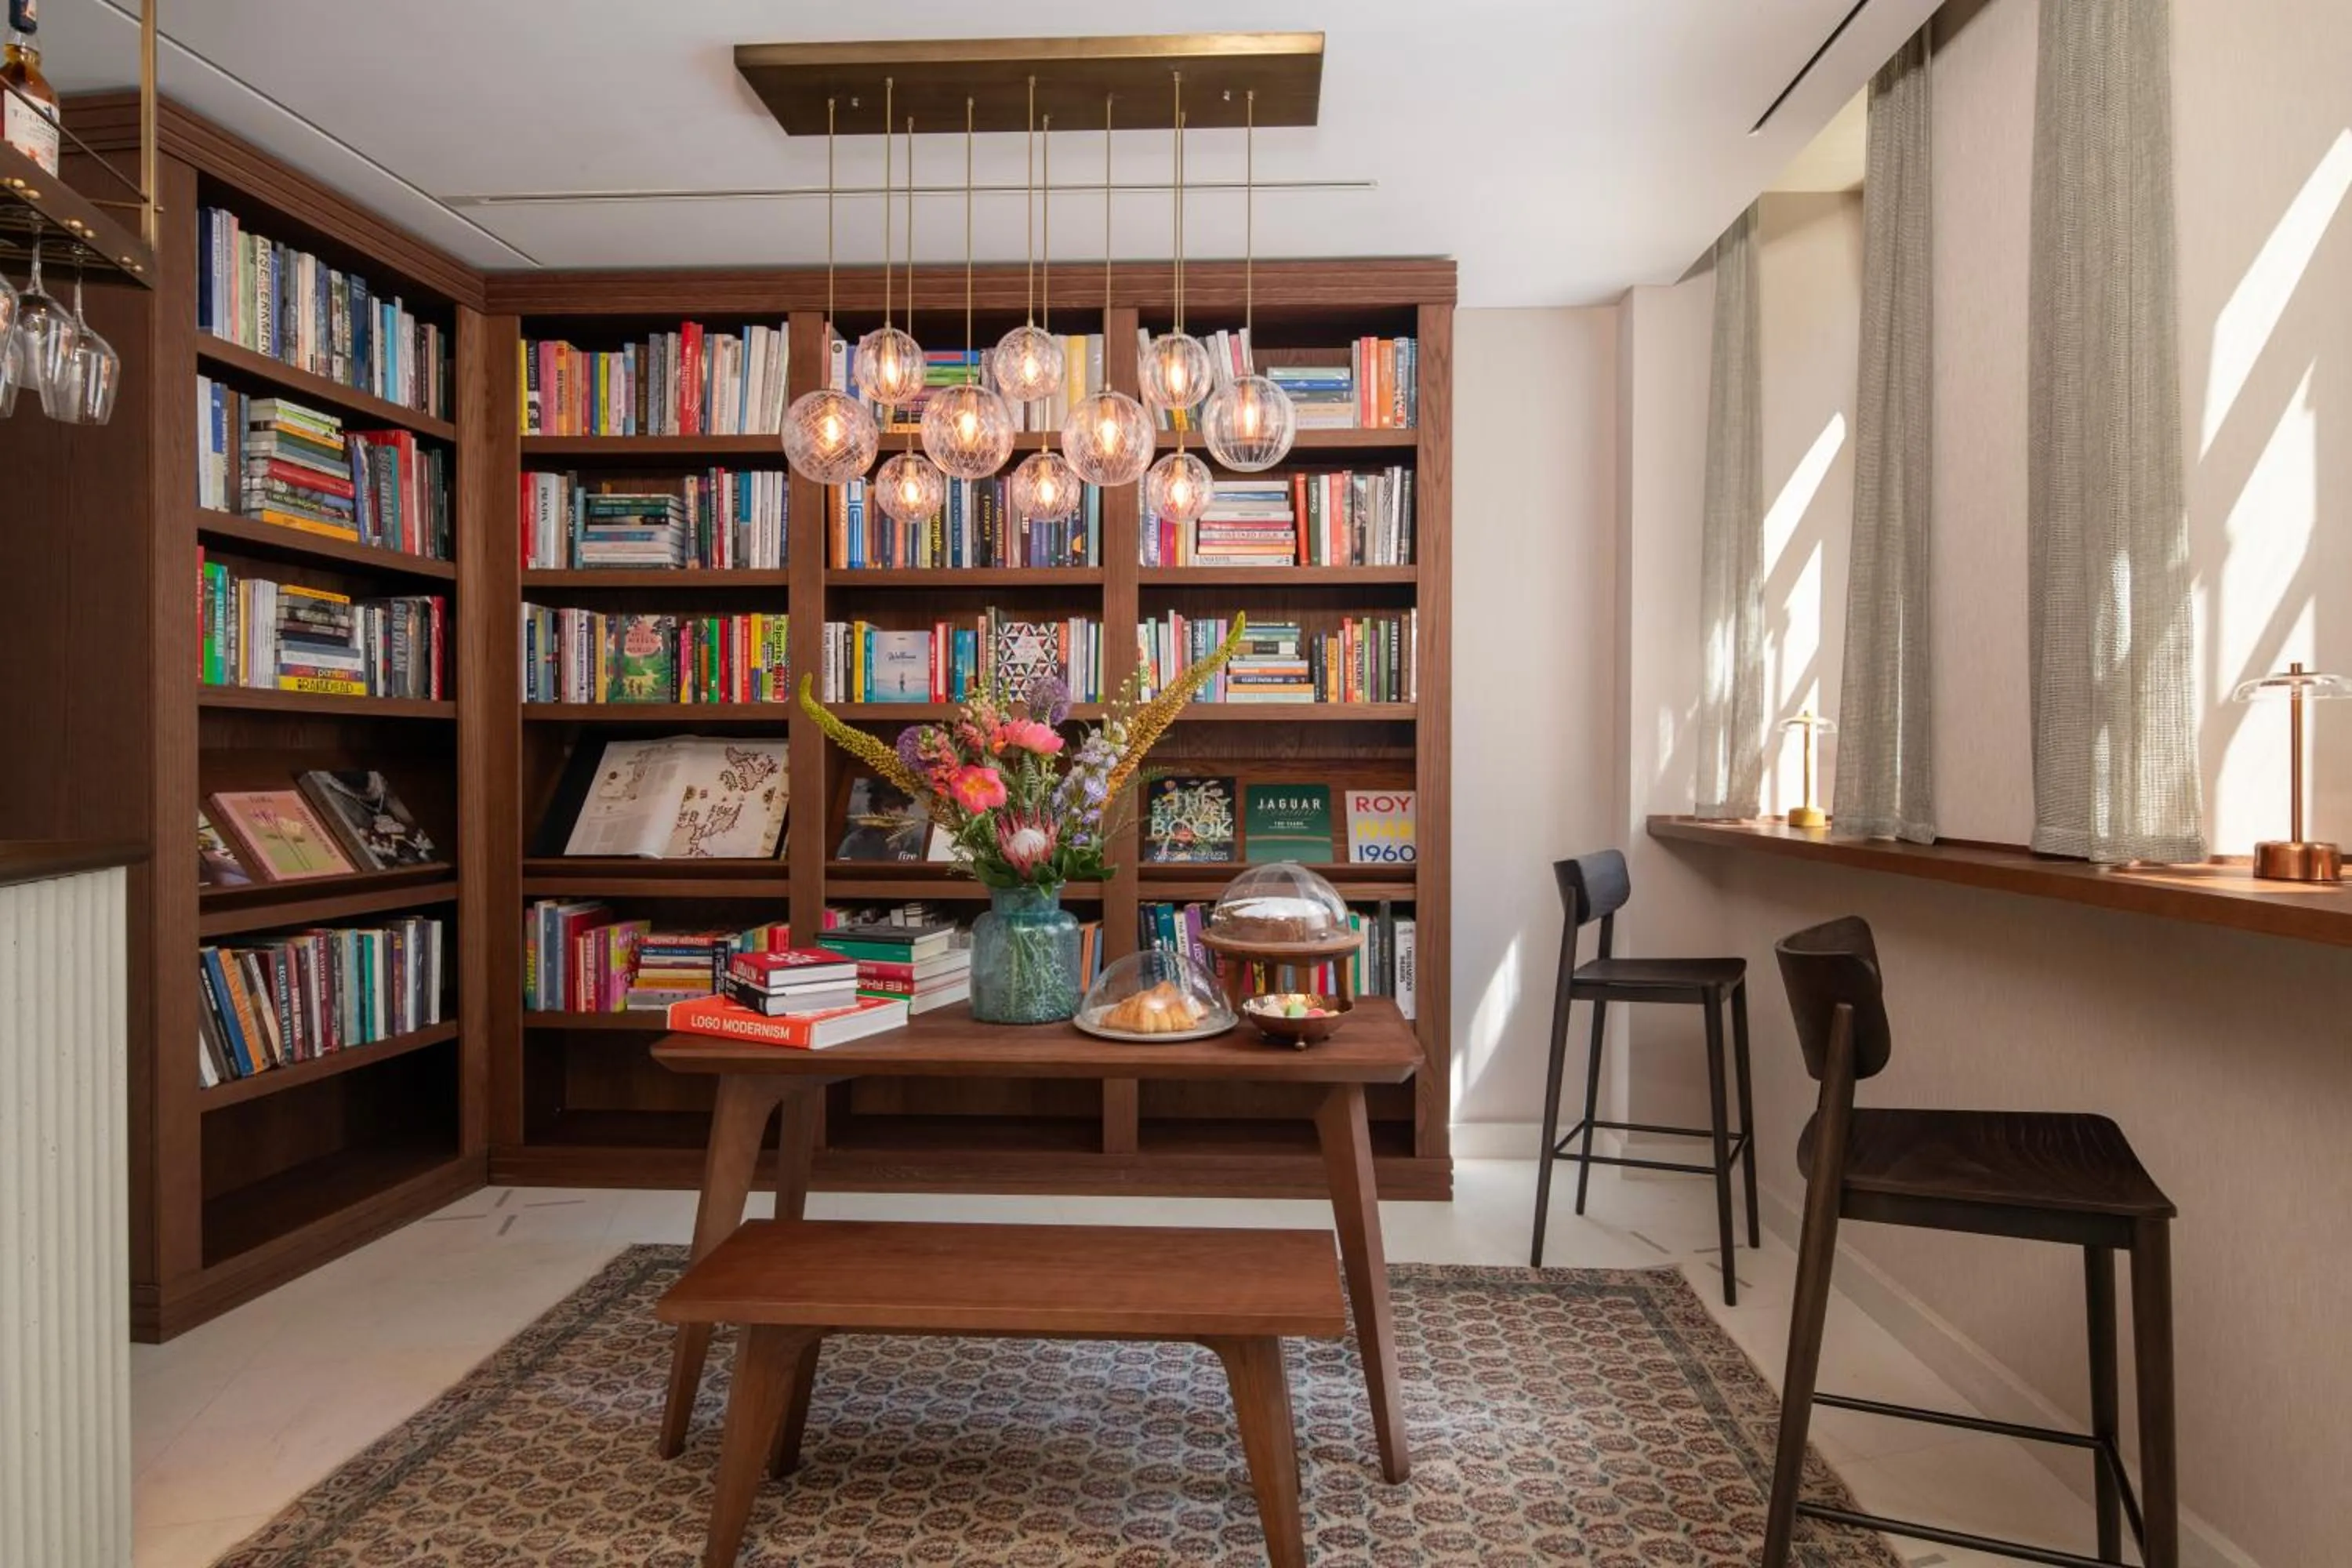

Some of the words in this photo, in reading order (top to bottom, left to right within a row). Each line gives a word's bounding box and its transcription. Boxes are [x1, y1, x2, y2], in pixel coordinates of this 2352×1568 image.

[1257, 797, 1321, 811] JAGUAR
[1355, 796, 1412, 813] ROY
[1151, 816, 1233, 839] BOOK
[1358, 844, 1417, 862] 1960
[690, 1014, 720, 1029] LOGO
[722, 1018, 790, 1040] MODERNISM
